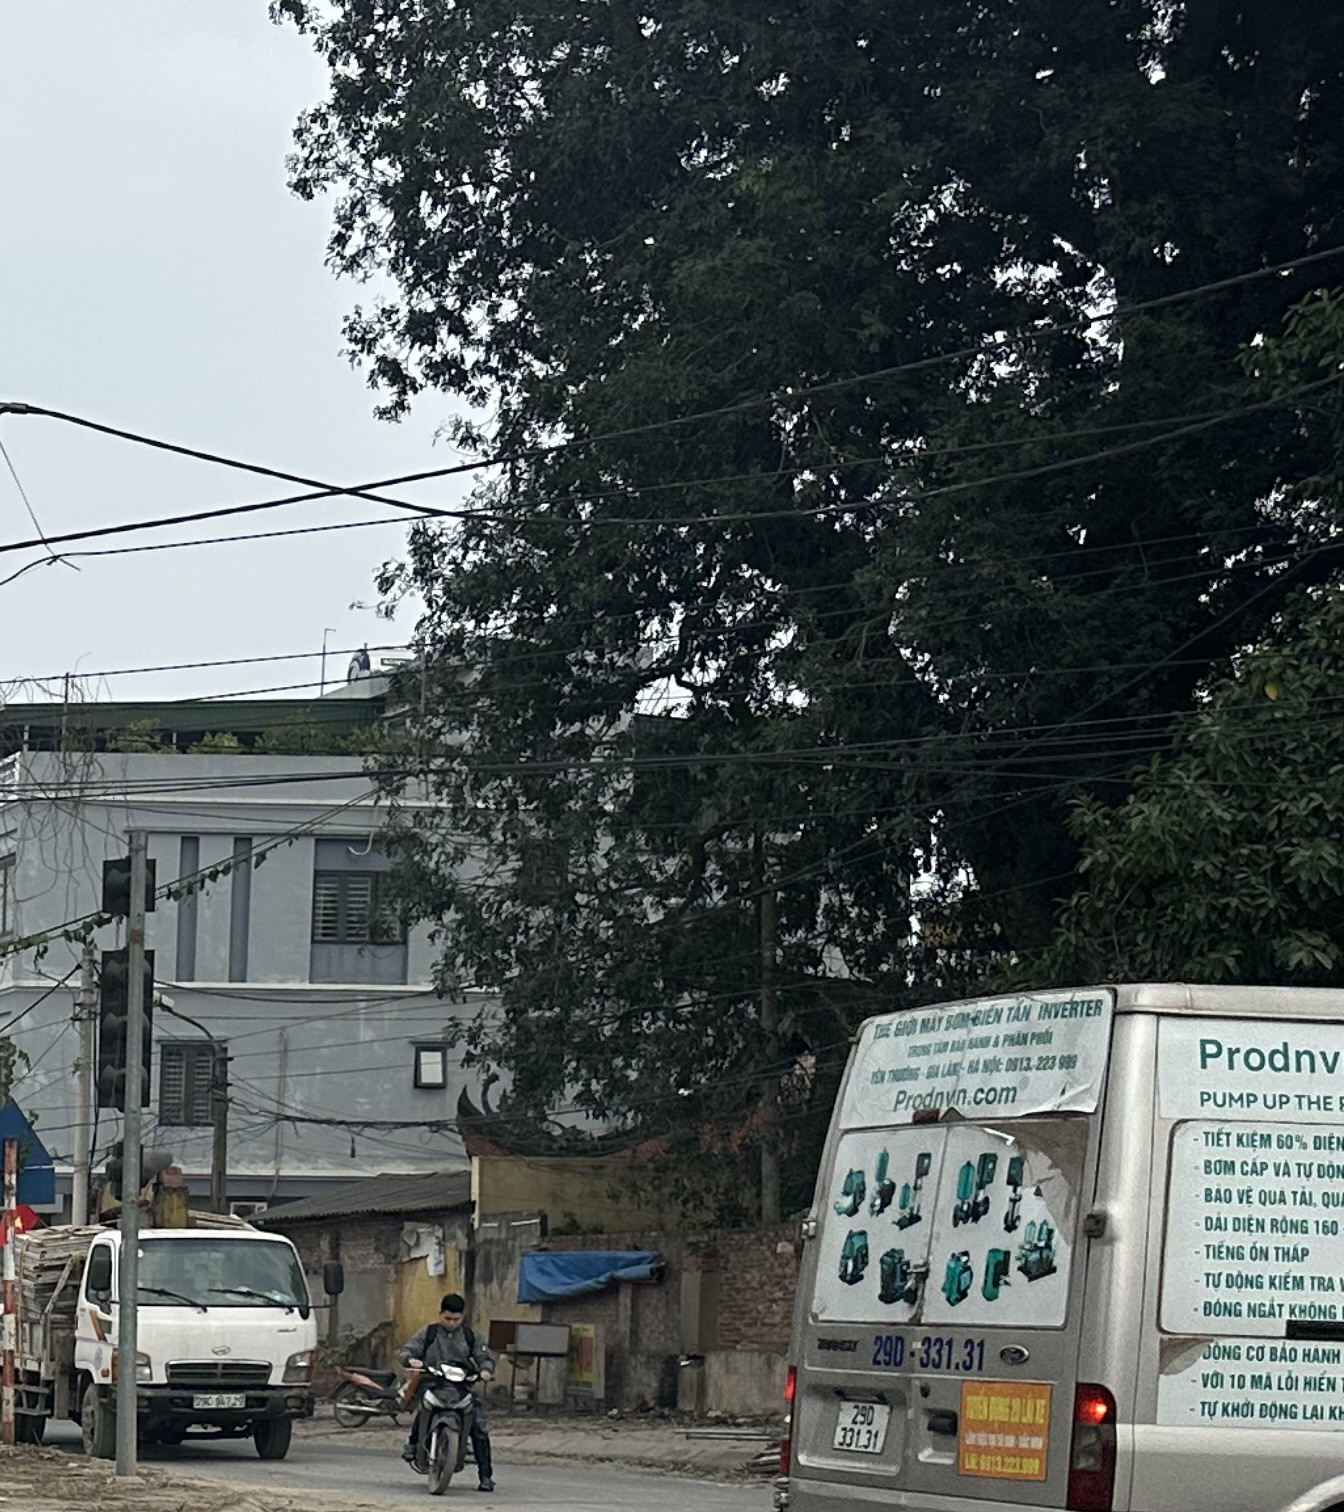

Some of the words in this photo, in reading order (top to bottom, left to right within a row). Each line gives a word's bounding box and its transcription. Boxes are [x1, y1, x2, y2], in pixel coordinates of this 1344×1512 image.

[1037, 999, 1104, 1020] INVERTER
[993, 1034, 1000, 1048] &
[1036, 1055, 1057, 1071] 223
[893, 1086, 1017, 1112] Prodnvn.com
[1200, 1091, 1258, 1108] PUMP
[1263, 1094, 1290, 1110] UP
[1294, 1095, 1334, 1111] THE
[1203, 1127, 1232, 1147] TIẾT
[1236, 1130, 1272, 1152] KIỆM
[1276, 1134, 1308, 1150] 60%
[1203, 1158, 1236, 1176] BƠM
[1240, 1155, 1268, 1177] CẤP
[1273, 1160, 1291, 1178] VÀ
[1295, 1162, 1314, 1182] TỰ
[1204, 1183, 1232, 1203] BẢO
[1237, 1186, 1254, 1208] VỆ
[1258, 1187, 1287, 1207] QUÁ
[1291, 1185, 1318, 1208] TẢI,
[1270, 1215, 1309, 1238] RỘNG
[1314, 1219, 1339, 1236] 160
[1204, 1240, 1245, 1261] TIẾNG
[1273, 1241, 1310, 1263] THẤP
[1204, 1272, 1223, 1292] TỰ
[1225, 1271, 1263, 1293] ĐỘNG
[1269, 1269, 1305, 1292] KIỂM
[1309, 1275, 1336, 1292] TRA
[1203, 1299, 1242, 1318] ĐÓNG
[1247, 1297, 1285, 1319] NGẮT
[1288, 1300, 1337, 1320] KHÔNG
[872, 1335, 905, 1367] 29D
[919, 1336, 986, 1372] 331.31
[1246, 1344, 1266, 1362] CƠ
[1269, 1342, 1298, 1363] BẢO
[1302, 1345, 1341, 1364] HÀNH
[1201, 1370, 1224, 1389] VỚI
[1229, 1374, 1246, 1389] 10
[1250, 1372, 1273, 1391] MÃ
[1277, 1370, 1299, 1391] LỖI
[1303, 1371, 1337, 1393] HIỂN
[851, 1404, 874, 1426] 29D
[1200, 1401, 1219, 1420] TỰ
[1221, 1398, 1255, 1418] KHỞI
[1259, 1401, 1298, 1423] ĐỘNG
[1302, 1404, 1324, 1424] LẠI
[838, 1426, 879, 1450] 331.31
